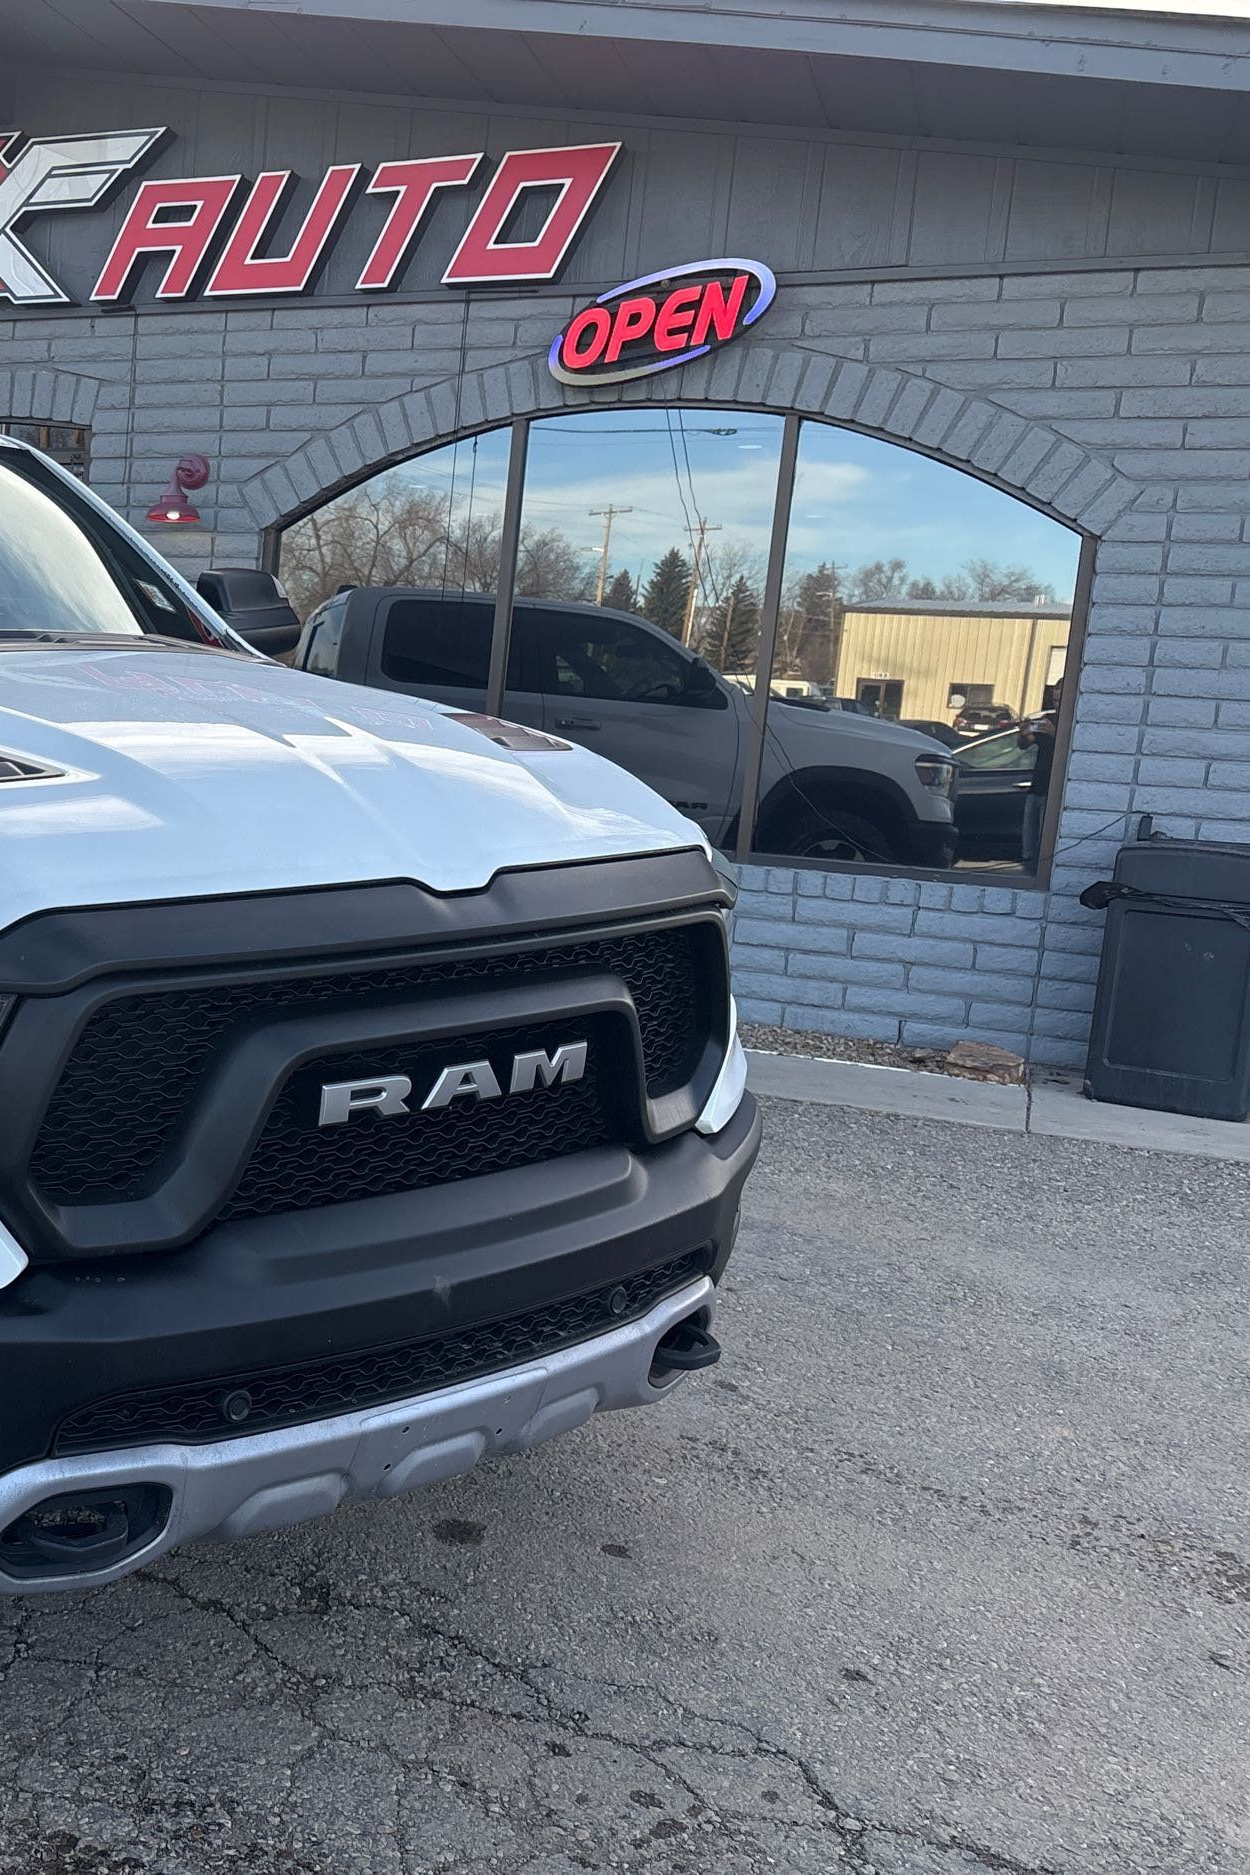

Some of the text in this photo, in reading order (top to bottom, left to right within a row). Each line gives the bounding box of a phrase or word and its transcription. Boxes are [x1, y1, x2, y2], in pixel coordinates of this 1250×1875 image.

[89, 140, 623, 302] AUTO
[562, 274, 750, 370] OPEN
[318, 1040, 588, 1127] RAM
